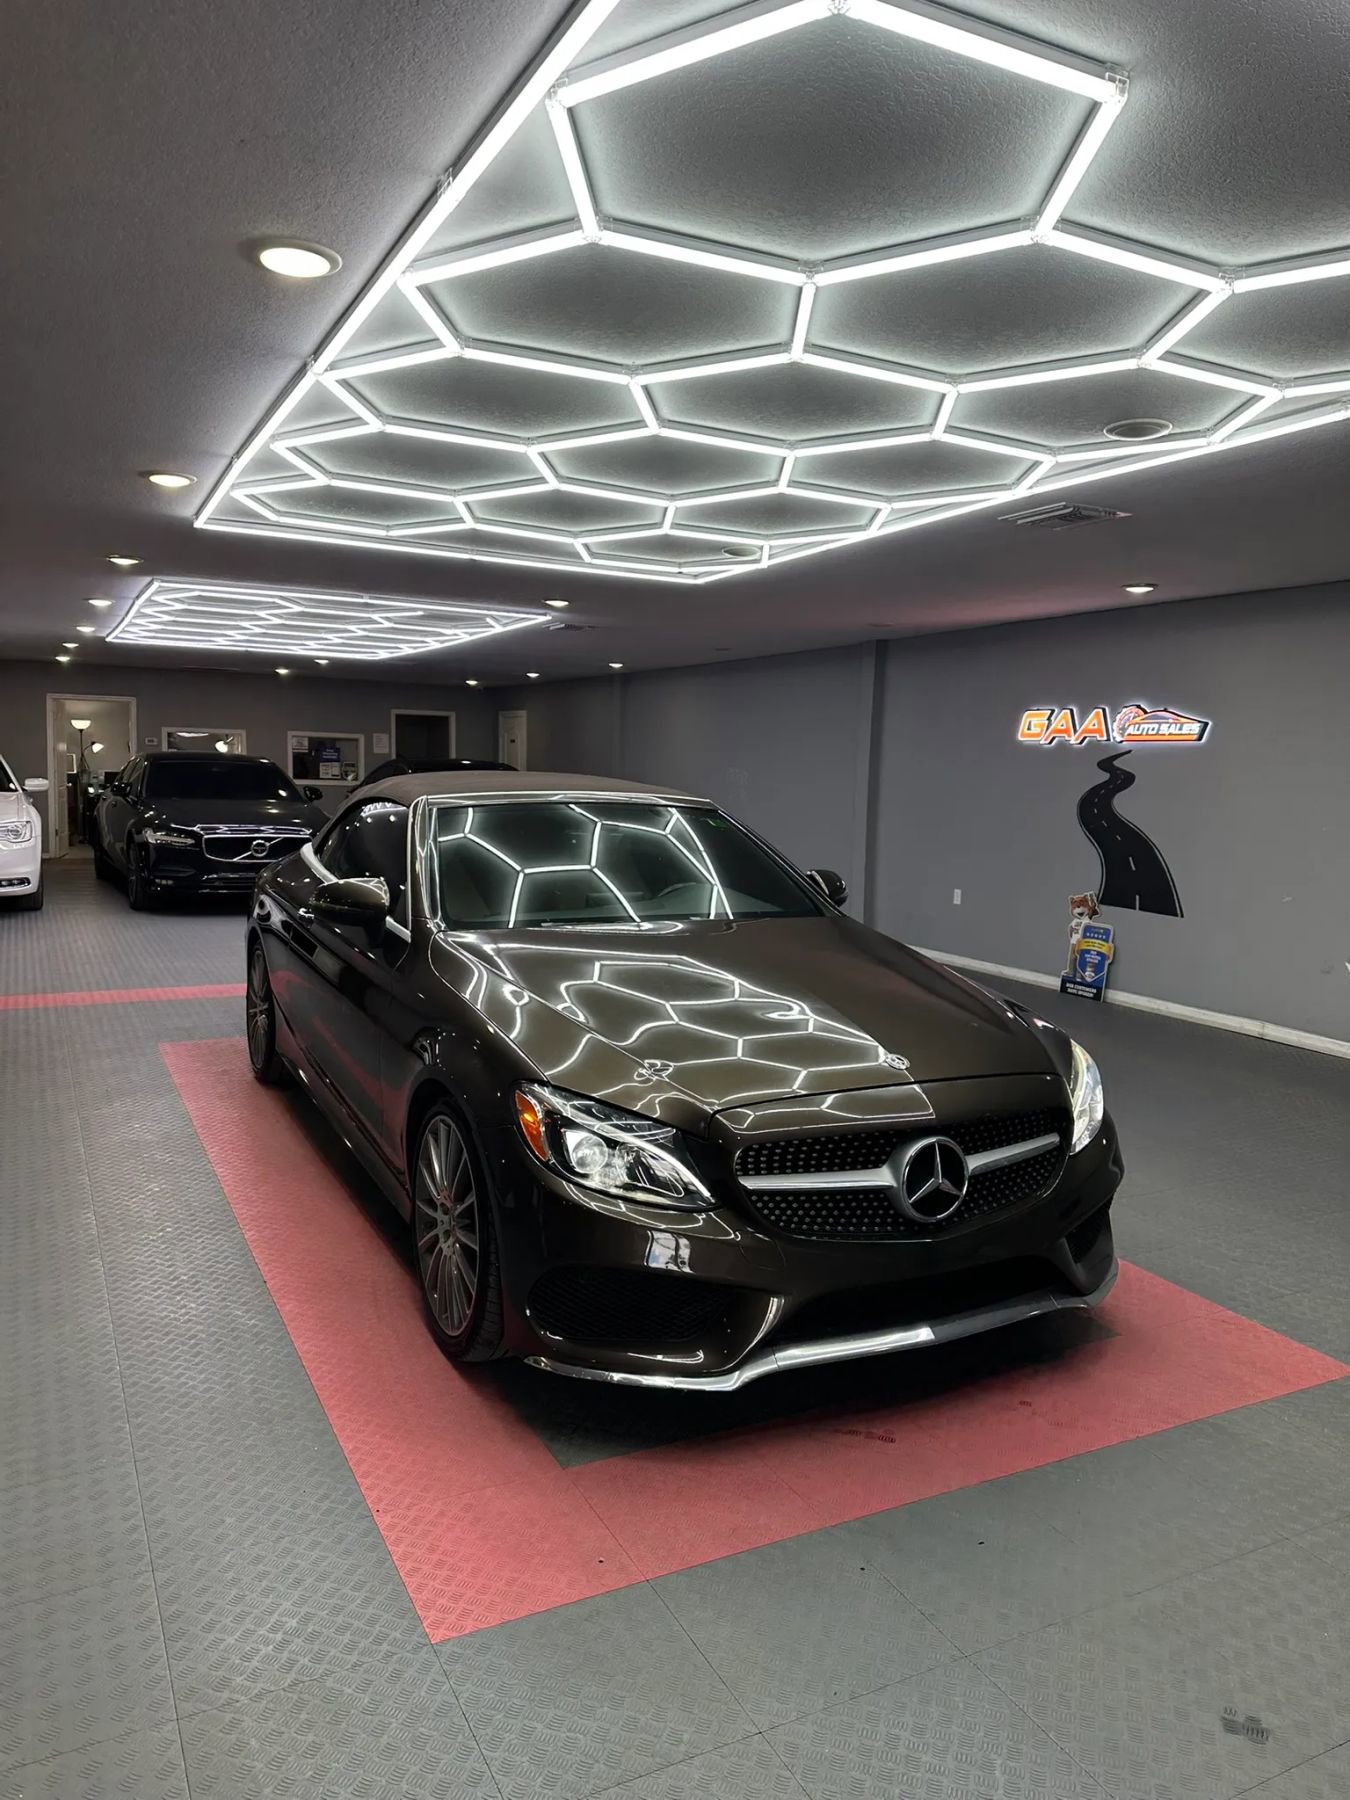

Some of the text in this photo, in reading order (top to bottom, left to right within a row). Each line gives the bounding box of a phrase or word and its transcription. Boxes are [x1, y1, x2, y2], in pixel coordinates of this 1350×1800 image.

[1018, 708, 1109, 745] GAA
[1127, 722, 1202, 736] AUTO SALES
